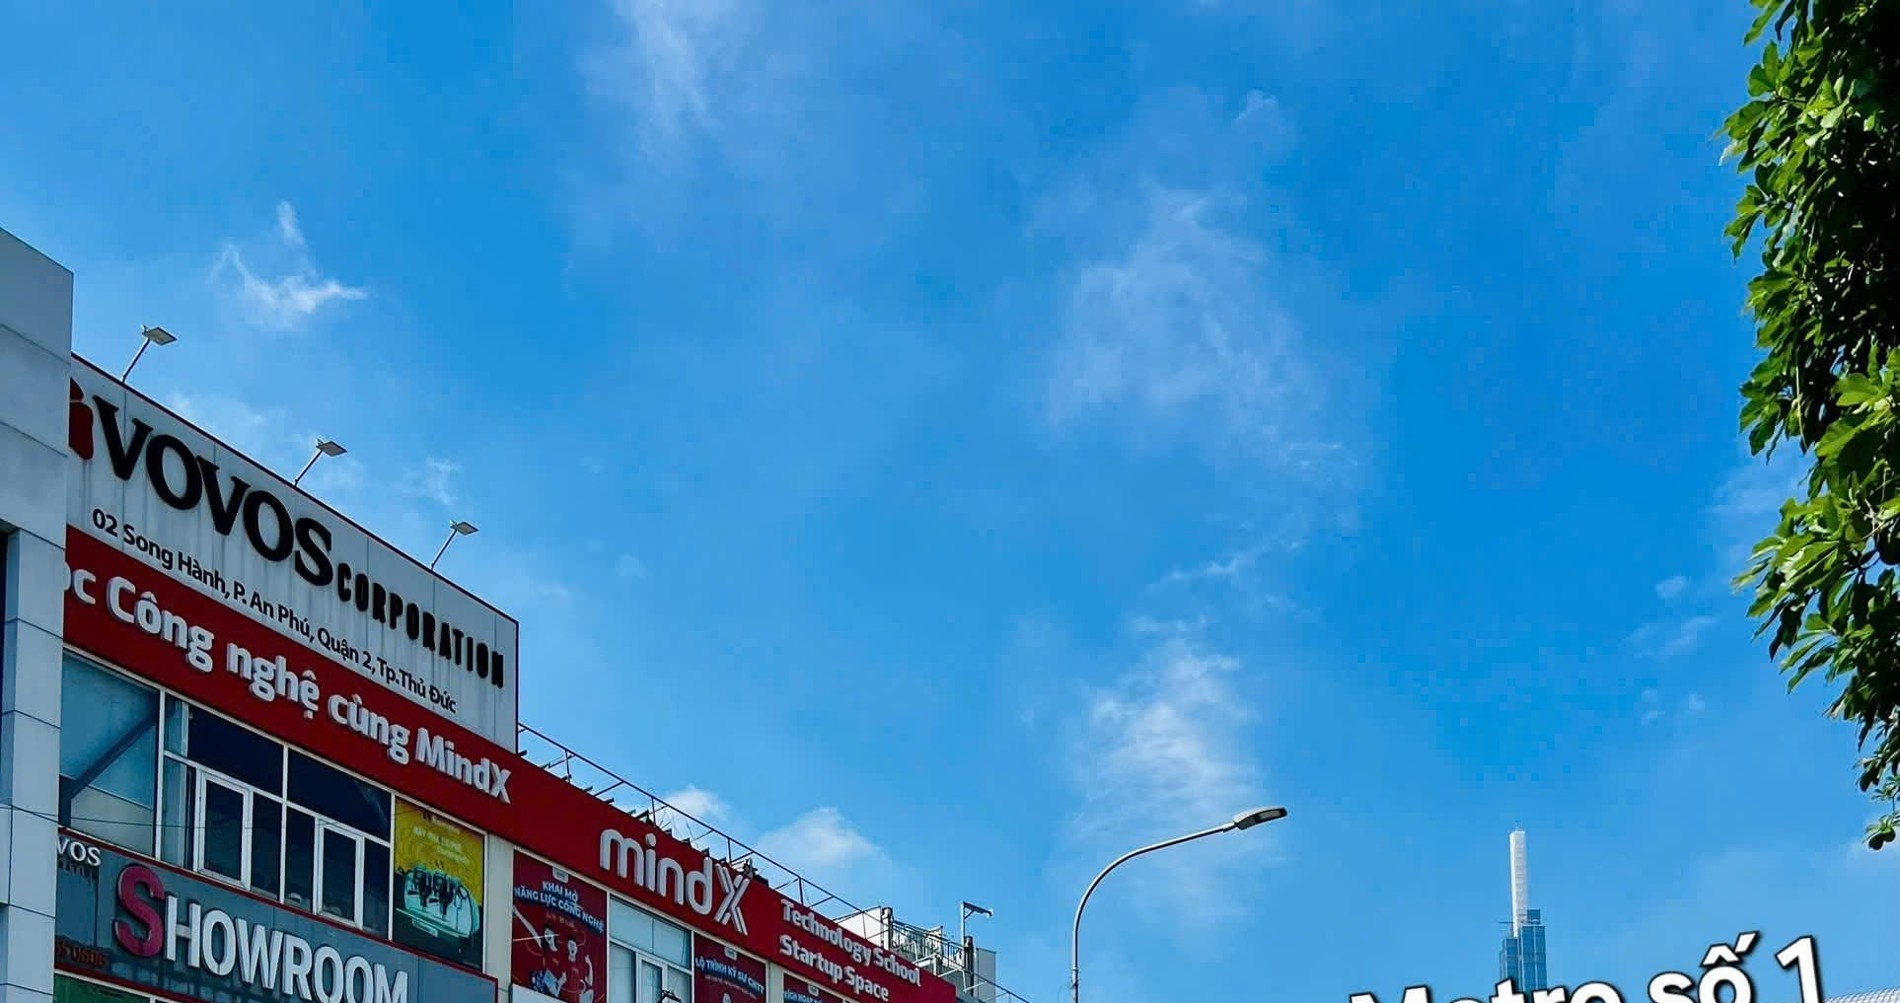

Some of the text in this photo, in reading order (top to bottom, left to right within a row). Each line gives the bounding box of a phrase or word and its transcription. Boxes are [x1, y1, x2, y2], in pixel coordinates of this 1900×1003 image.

[92, 396, 333, 586] VOVOS
[92, 508, 119, 536] 02
[124, 525, 174, 571] Song
[177, 551, 230, 602] Hành,
[233, 580, 247, 602] P.
[250, 591, 275, 617] An
[278, 605, 315, 643] Phú,
[317, 625, 359, 661] Quận
[429, 681, 457, 714] Đức
[337, 563, 505, 688] CORPORATION
[107, 575, 215, 672] Công
[227, 642, 320, 718] nghệ
[328, 690, 411, 765] cùng
[415, 727, 512, 804] MindX
[600, 828, 749, 936] mindX
[780, 898, 922, 988] Technology School
[779, 934, 890, 1003] Startup Space
